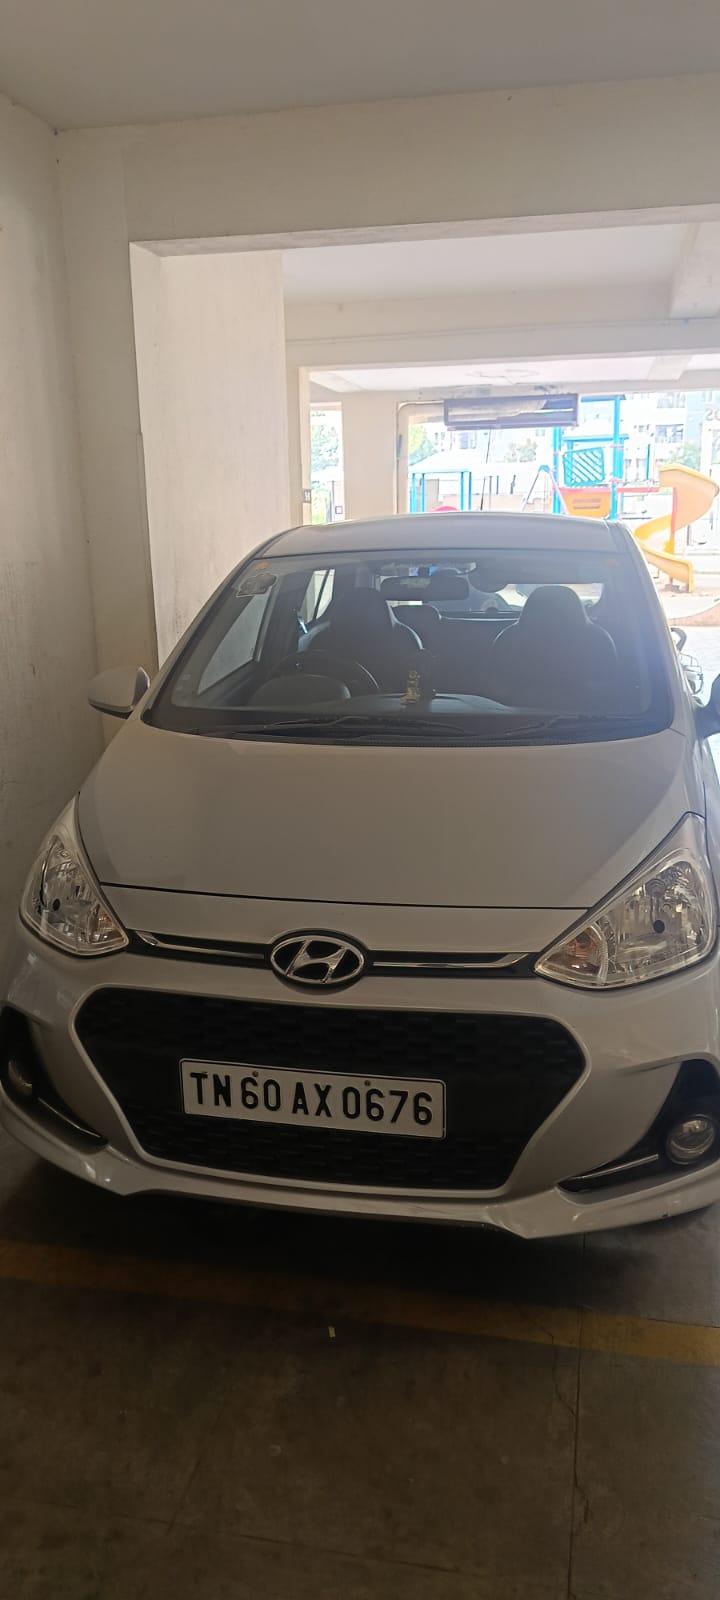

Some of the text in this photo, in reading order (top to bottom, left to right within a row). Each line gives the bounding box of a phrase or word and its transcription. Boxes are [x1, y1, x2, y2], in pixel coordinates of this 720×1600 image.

[190, 1071, 432, 1125] TN 60 AX 0676
